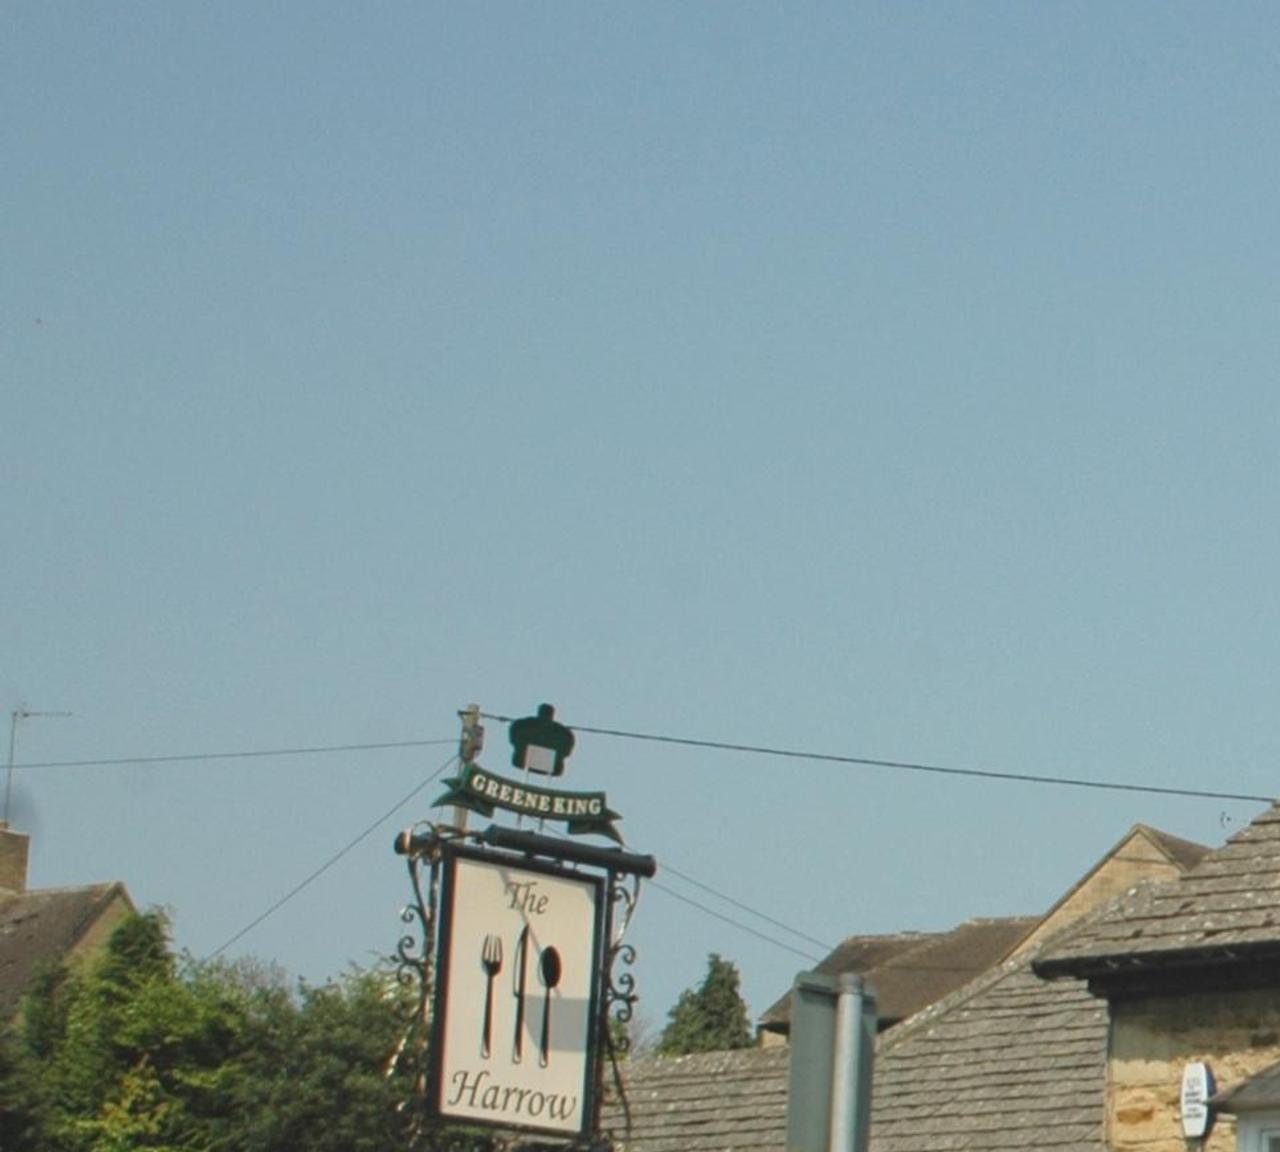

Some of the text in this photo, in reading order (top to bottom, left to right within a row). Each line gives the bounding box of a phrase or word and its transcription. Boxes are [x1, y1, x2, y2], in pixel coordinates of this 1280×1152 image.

[472, 774, 601, 815] GREENE KING
[504, 881, 549, 914] The
[447, 1070, 577, 1121] Harrow
